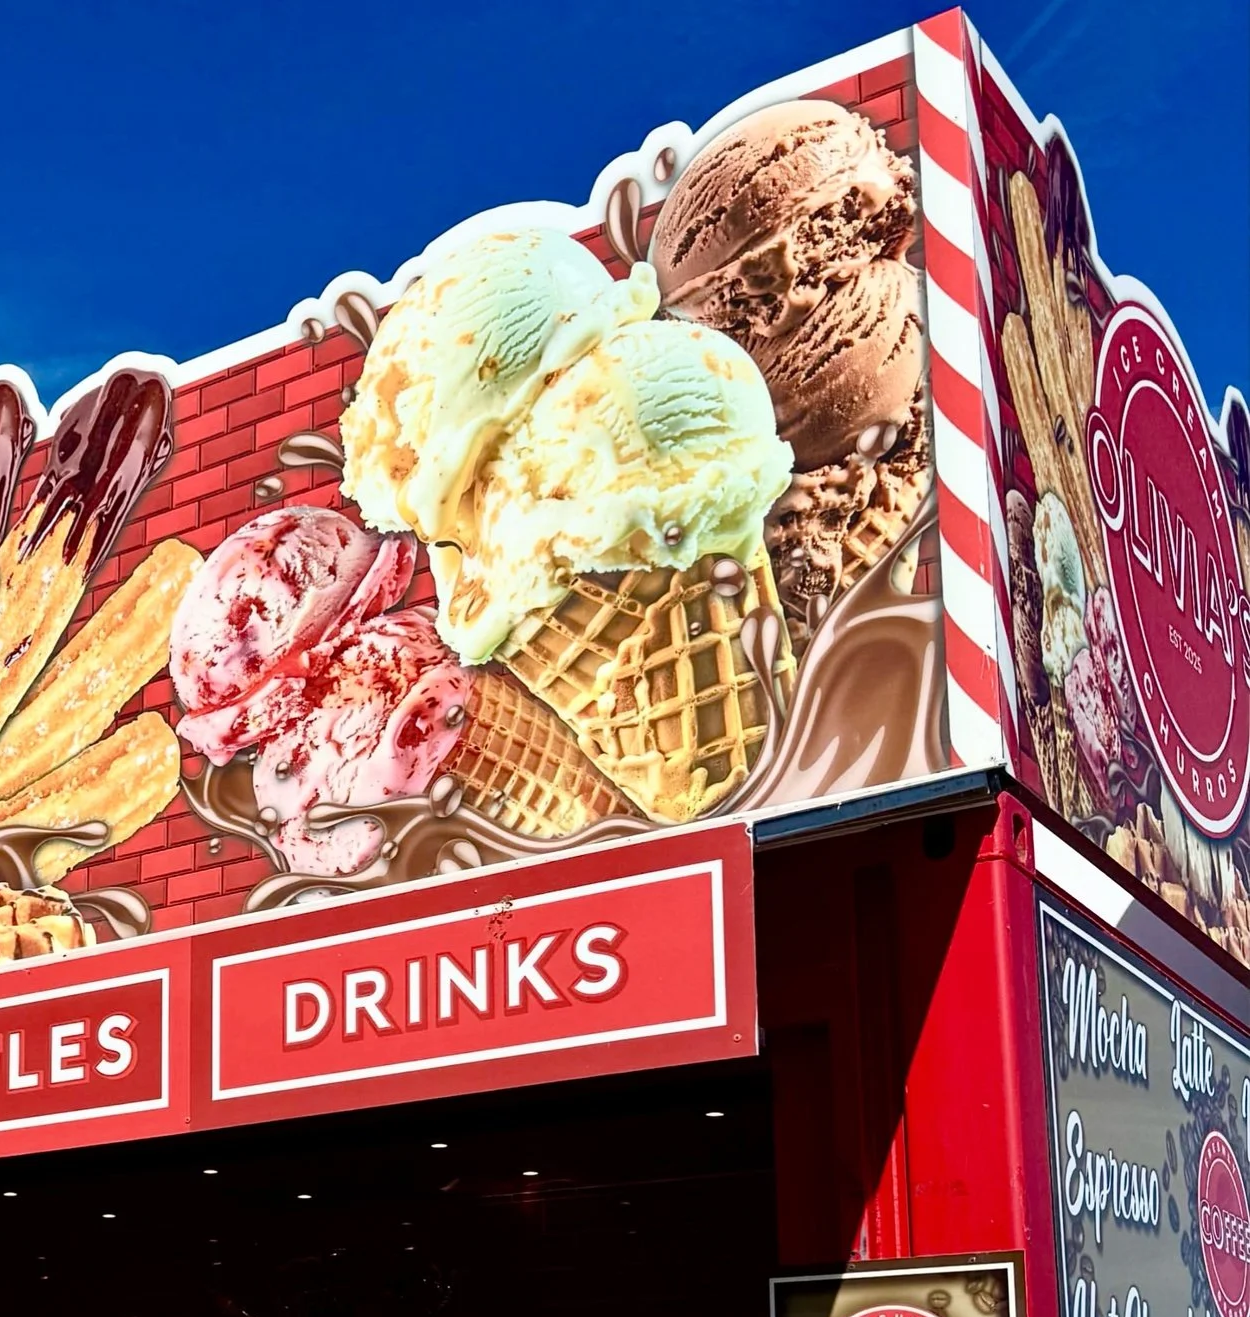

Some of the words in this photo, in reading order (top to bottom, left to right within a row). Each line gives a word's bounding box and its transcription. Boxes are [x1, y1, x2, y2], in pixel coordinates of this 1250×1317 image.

[1112, 336, 1142, 391] ICE
[1155, 348, 1223, 520] CREAM
[1169, 624, 1181, 652] EST
[1143, 672, 1237, 803] CHURROS
[282, 922, 628, 1051] DRINKS
[1062, 957, 1147, 1080] Mocha
[1170, 1000, 1215, 1102] Latte
[1064, 1109, 1160, 1244] Espresso
